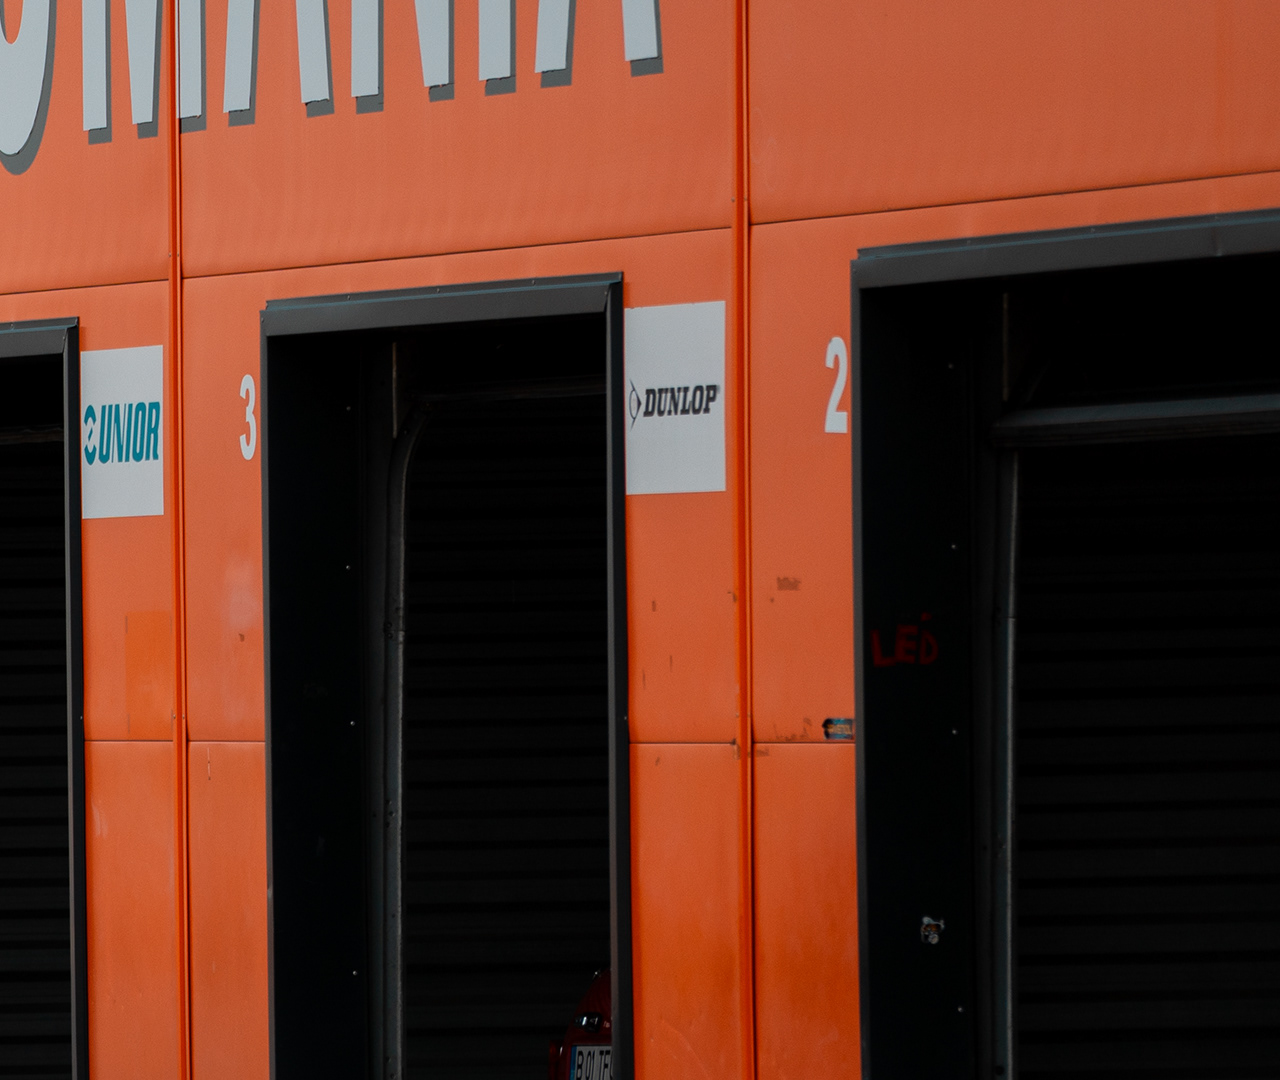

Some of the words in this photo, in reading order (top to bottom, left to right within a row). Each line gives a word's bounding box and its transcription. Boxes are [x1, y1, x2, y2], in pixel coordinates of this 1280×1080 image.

[239, 374, 256, 460] 3
[643, 384, 719, 417] DUNLOP
[824, 336, 848, 433] 2
[98, 401, 161, 464] UNIOR
